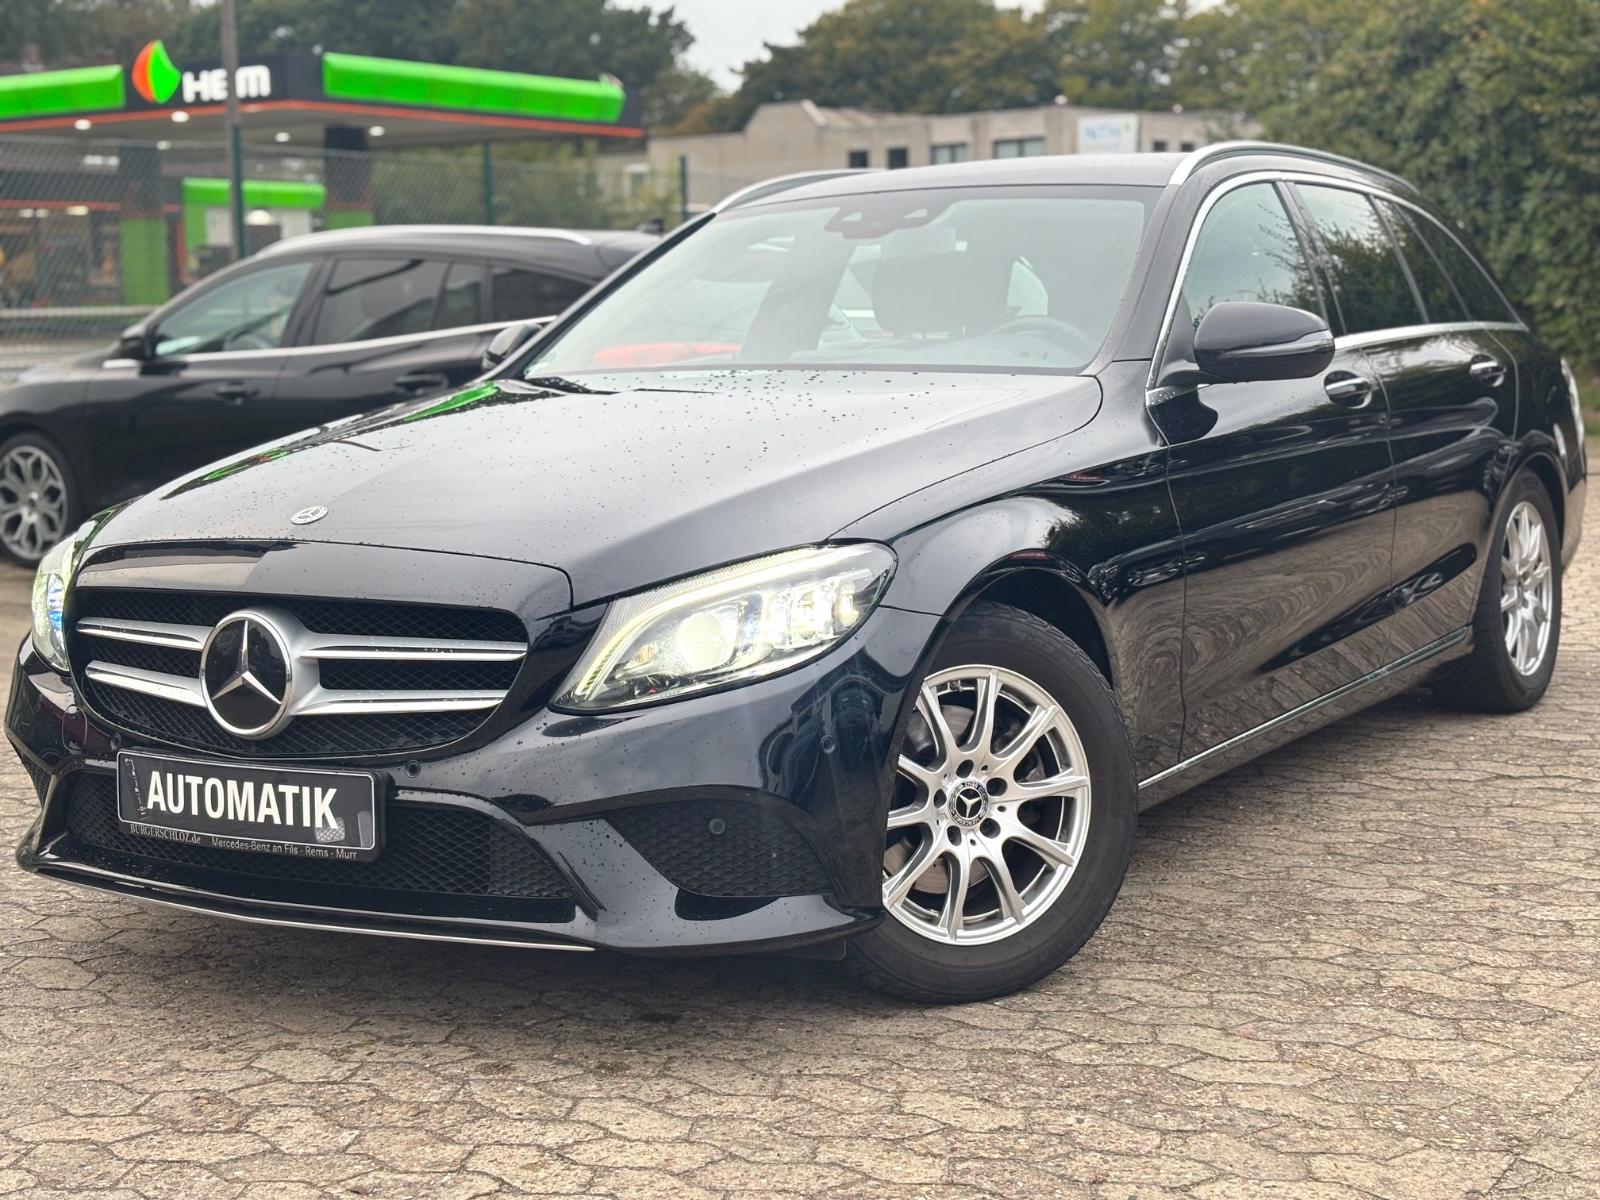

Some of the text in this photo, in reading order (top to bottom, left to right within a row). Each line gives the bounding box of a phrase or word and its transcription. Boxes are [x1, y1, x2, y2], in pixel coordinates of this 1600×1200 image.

[147, 771, 339, 829] AUTOMATIK
[211, 837, 357, 860] Mercedes-Benz an Fils Rems Murr
